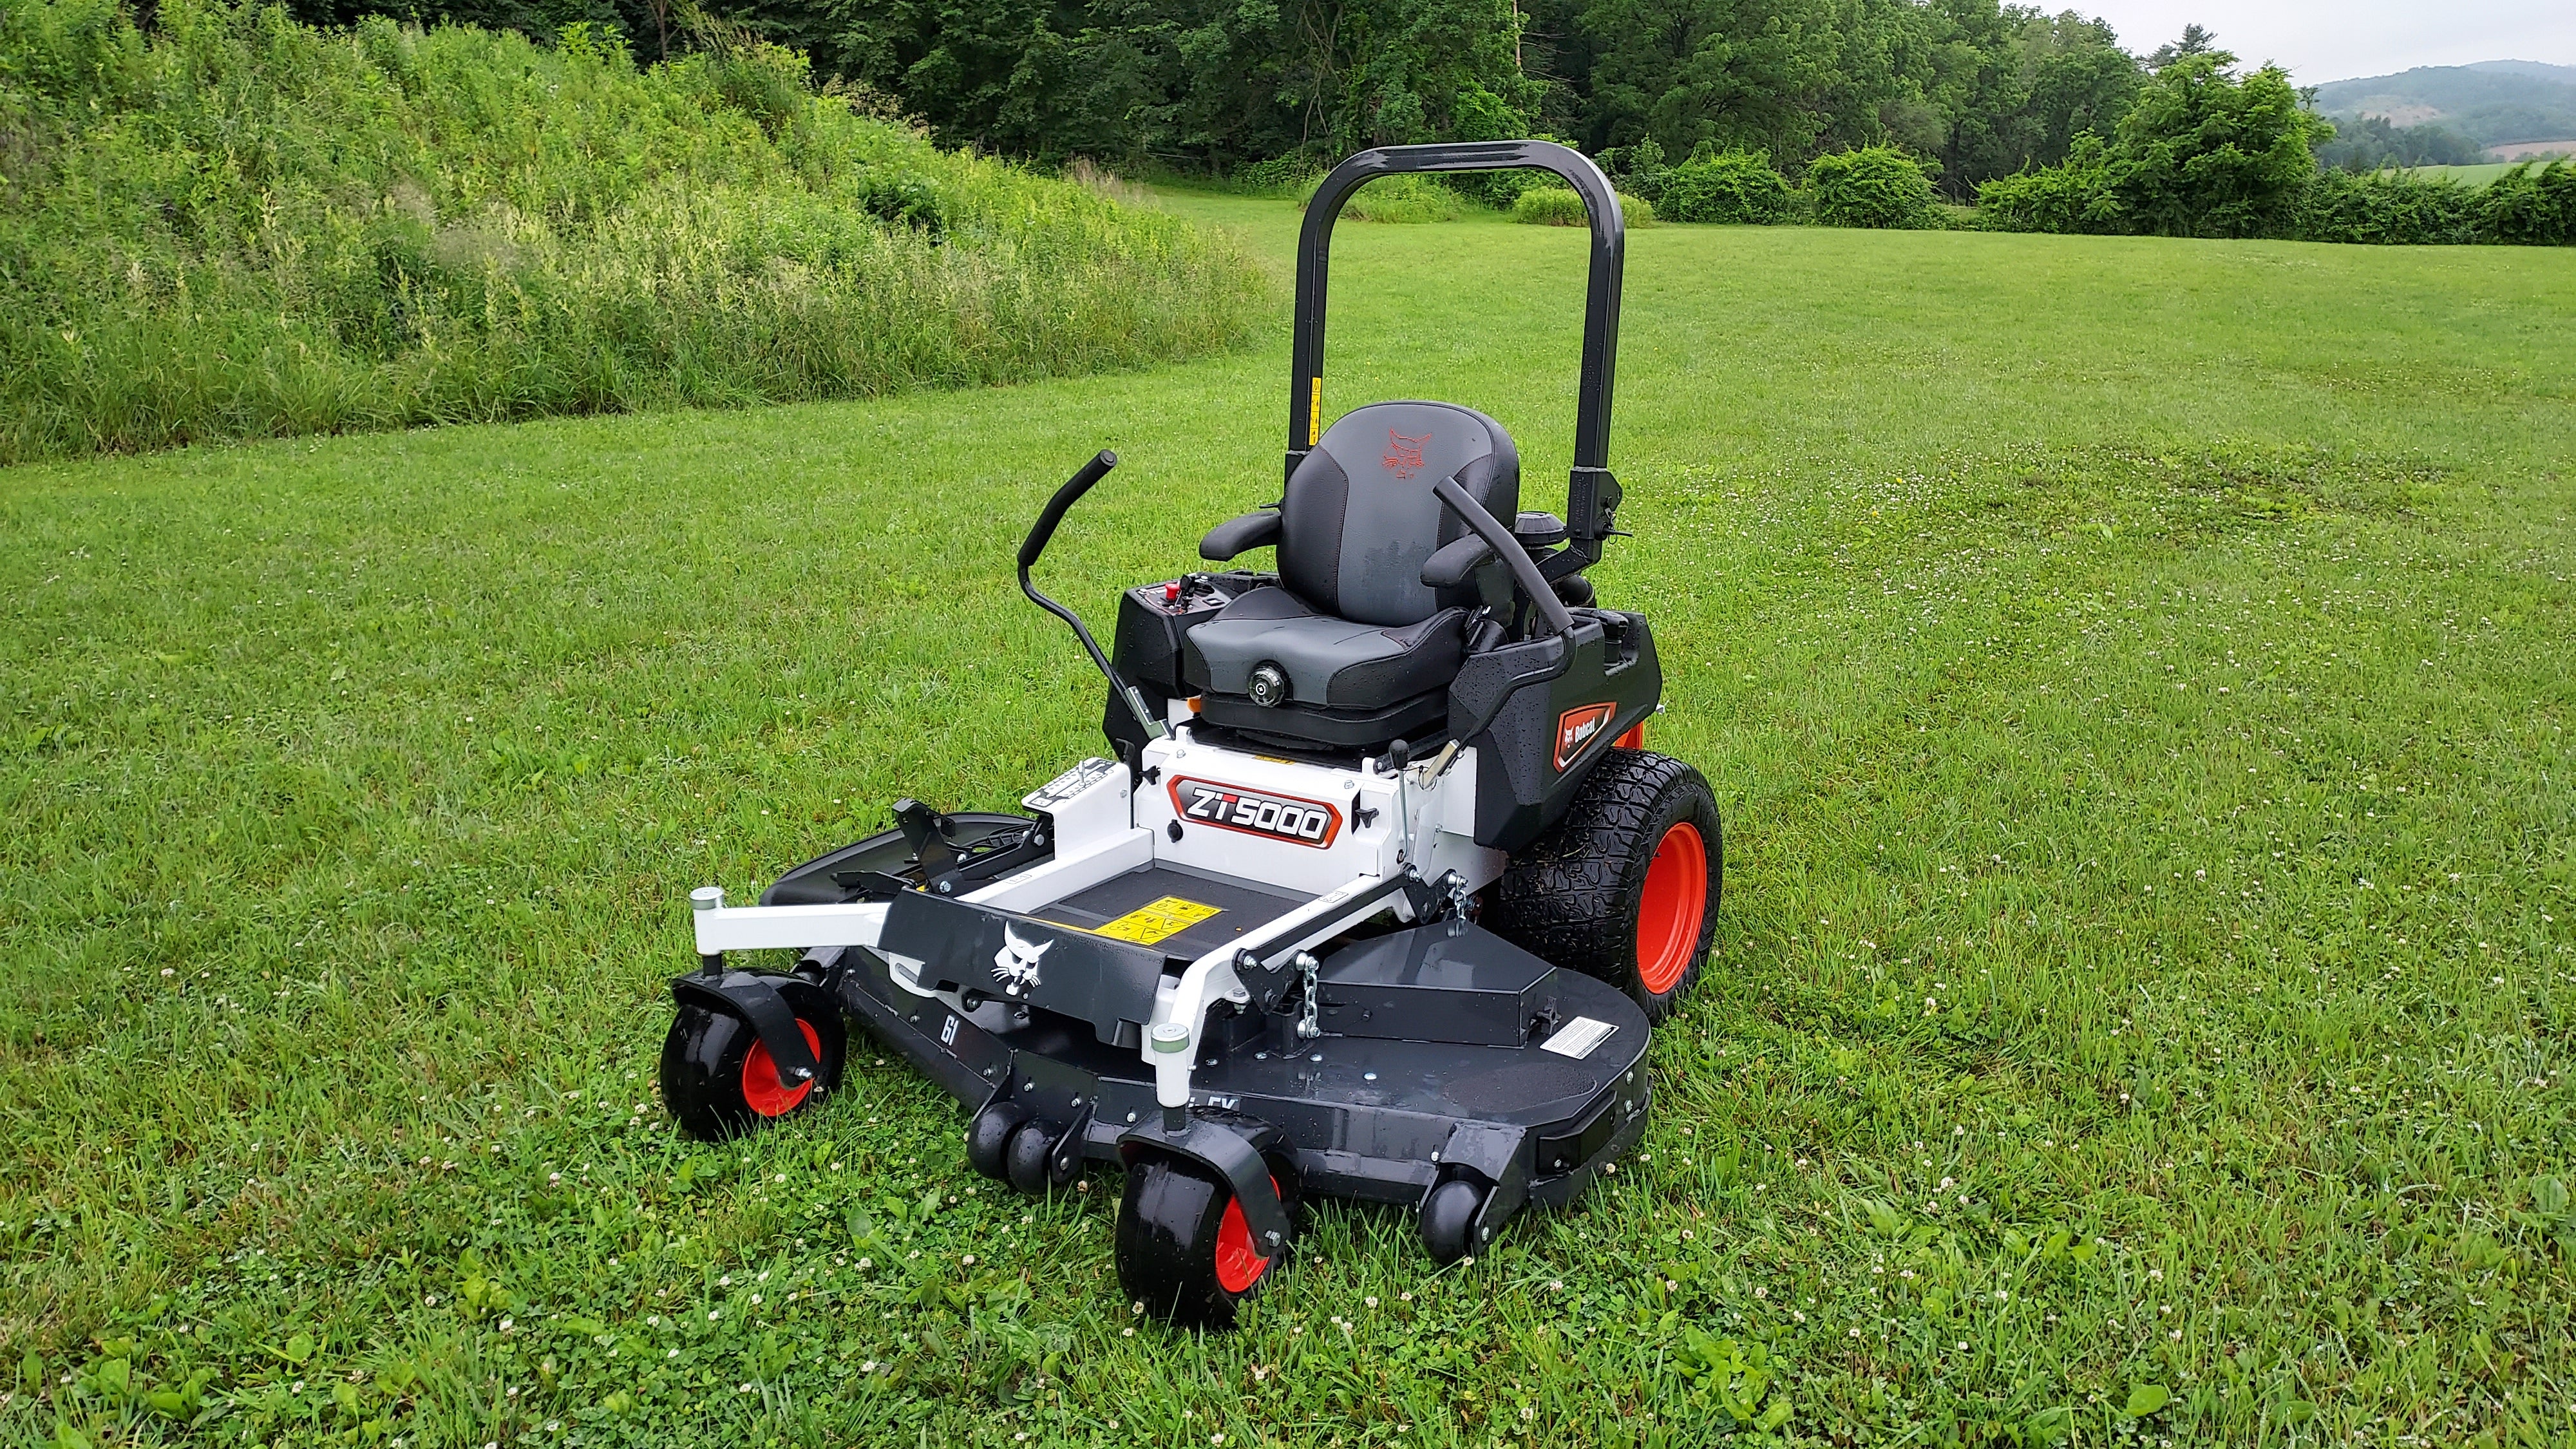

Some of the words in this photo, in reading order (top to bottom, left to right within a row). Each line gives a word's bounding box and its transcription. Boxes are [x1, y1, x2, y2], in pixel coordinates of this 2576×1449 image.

[1575, 716, 1595, 743] Bobcat
[1188, 788, 1328, 840] ZT5000
[941, 1014, 959, 1046] 61
